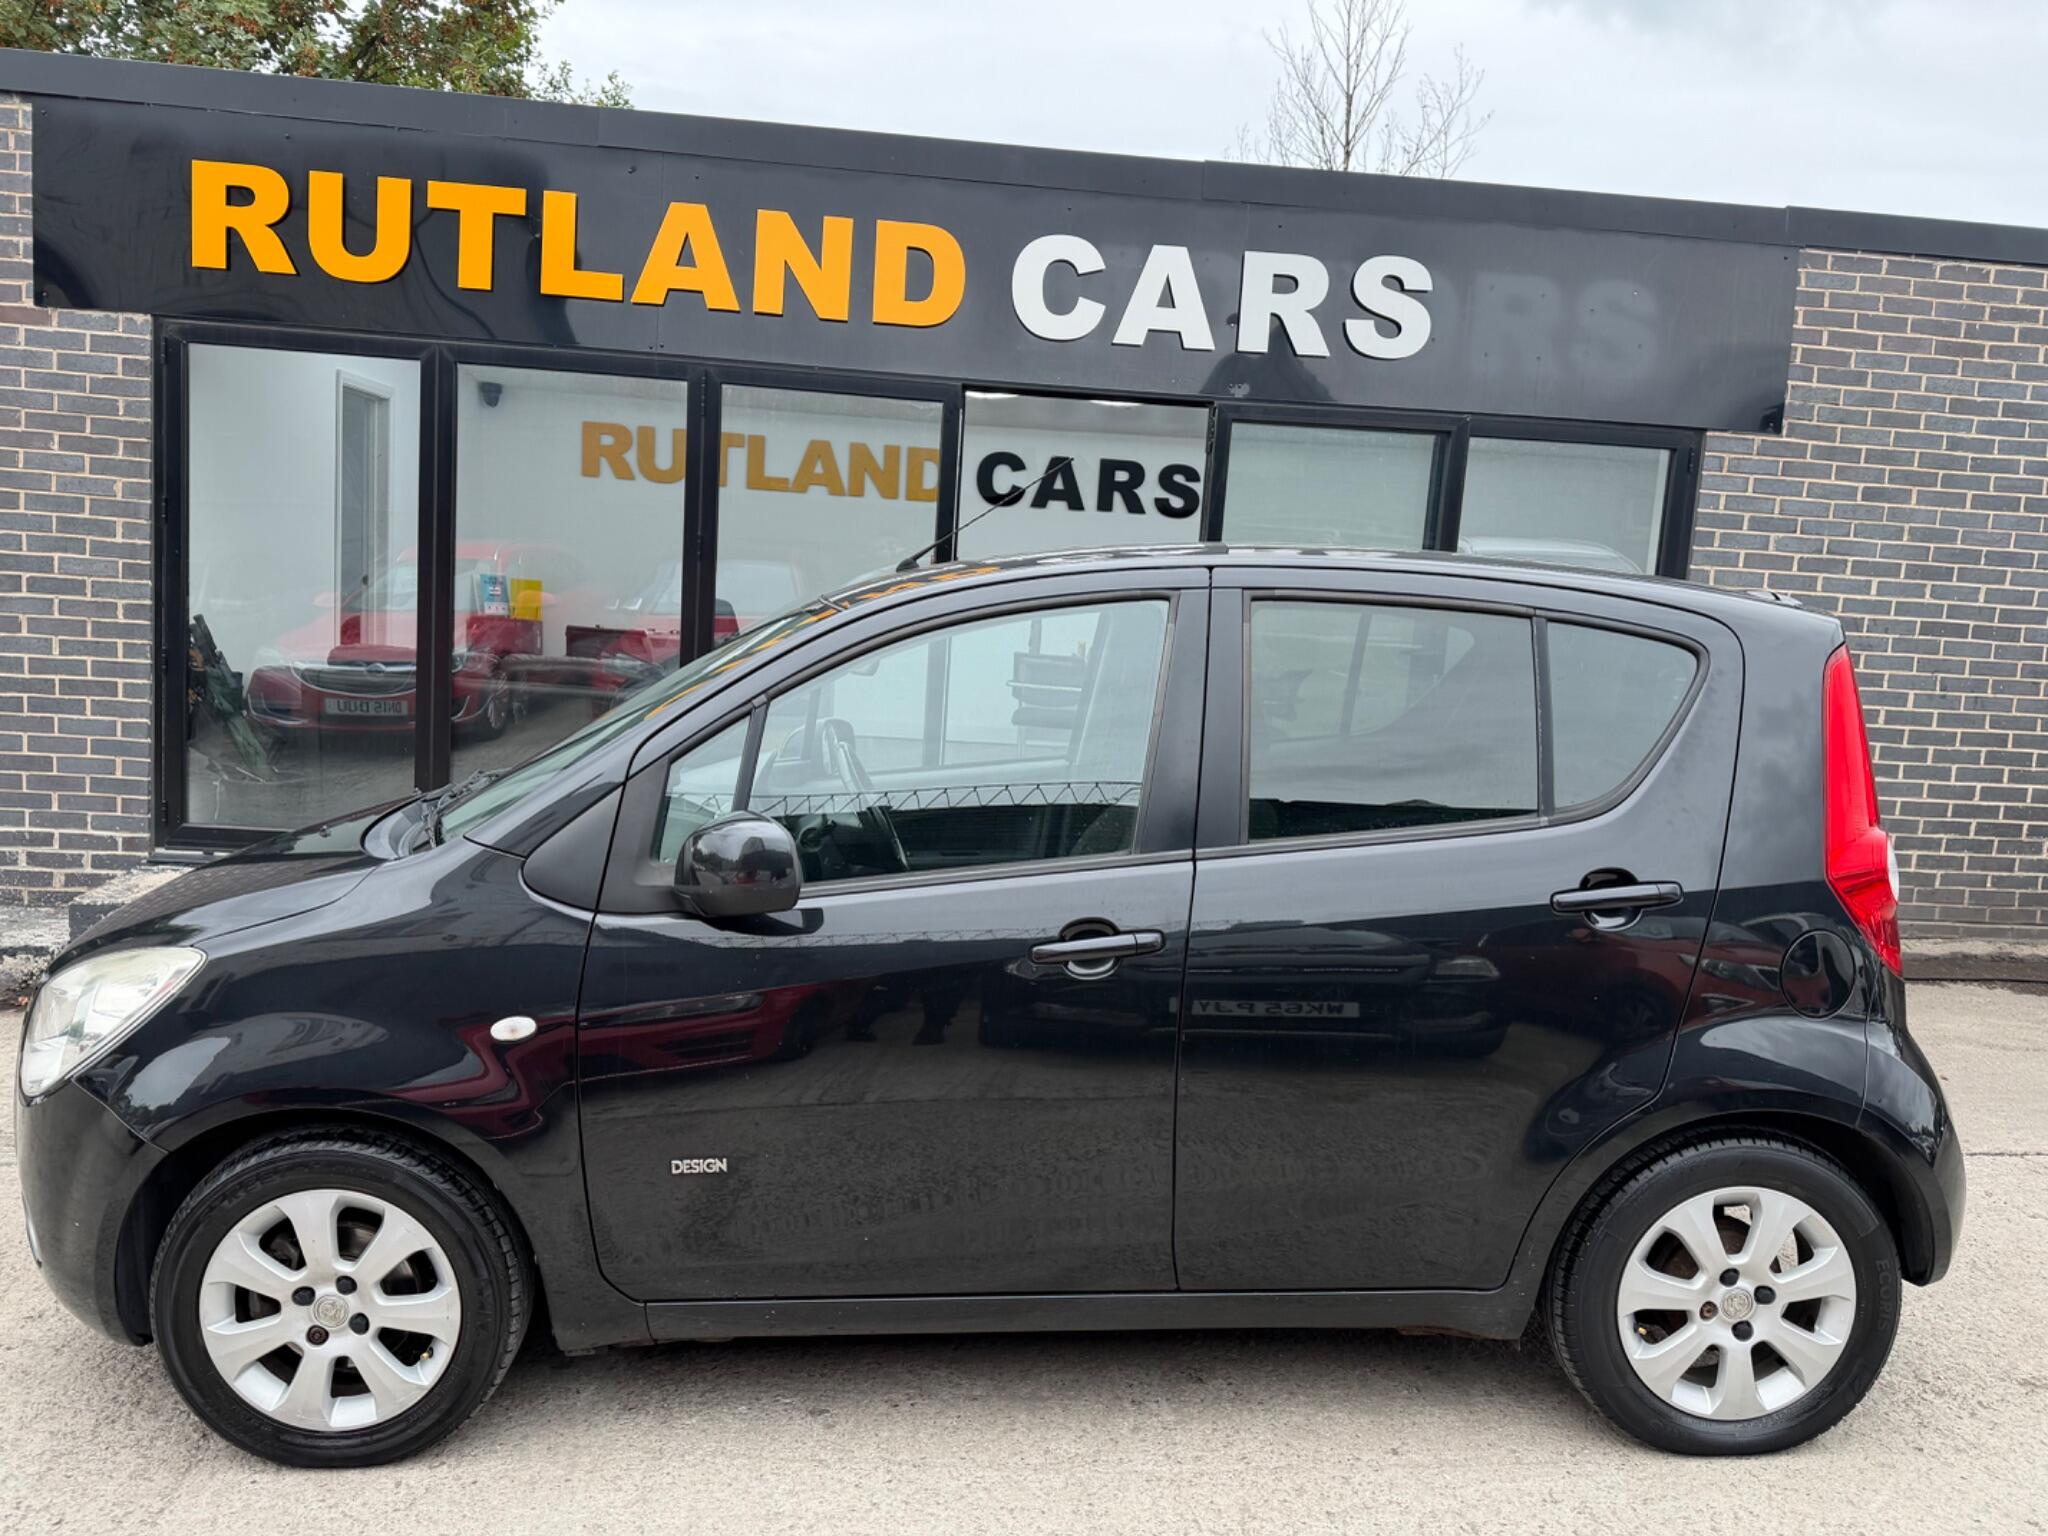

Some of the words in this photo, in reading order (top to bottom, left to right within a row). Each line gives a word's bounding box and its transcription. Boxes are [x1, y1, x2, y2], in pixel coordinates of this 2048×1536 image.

[191, 160, 966, 327] RUTLAND
[1011, 235, 1435, 359] CARS
[976, 451, 1204, 518] CARS
[671, 1158, 728, 1174] DESIGN
